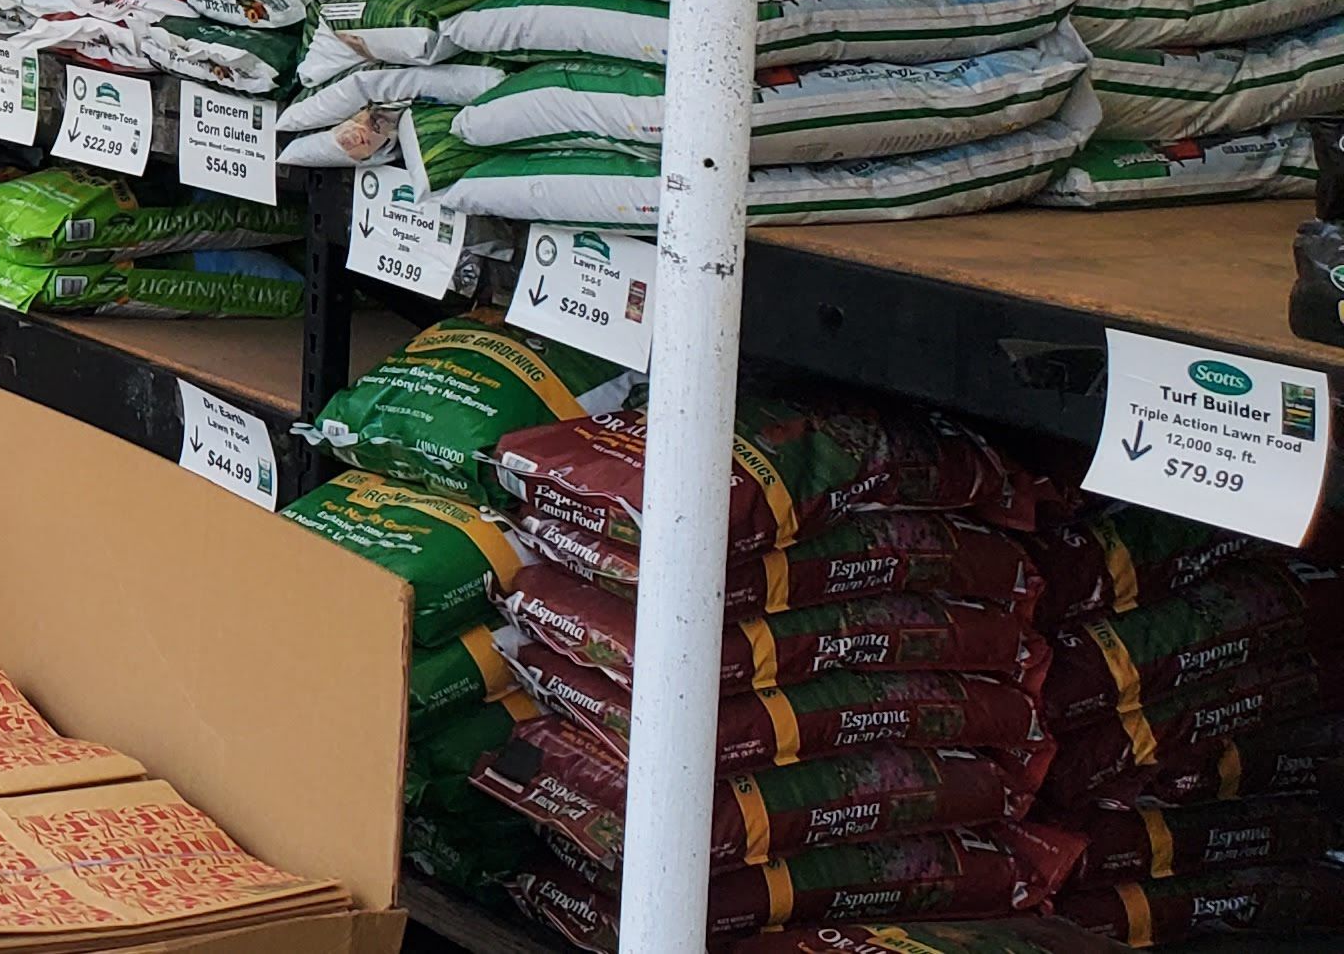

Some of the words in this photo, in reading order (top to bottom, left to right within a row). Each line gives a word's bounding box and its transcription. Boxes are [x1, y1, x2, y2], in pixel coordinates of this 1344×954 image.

[0, 64, 20, 79] Acting
[79, 104, 139, 127] Evergreen-Tone
[206, 99, 249, 120] Concern
[82, 135, 123, 156] $22.99
[196, 121, 221, 137] Corn
[223, 125, 258, 145] Gluten
[205, 155, 247, 179] $54.99
[382, 206, 408, 223] Lawn
[411, 214, 435, 231] Food
[392, 227, 421, 244] Organic
[376, 254, 422, 283] $39.99
[573, 255, 597, 272] Lawn
[598, 264, 620, 280] Food
[248, 284, 291, 307] LIME
[559, 297, 610, 327] $29.99
[474, 336, 547, 384] GARDENING
[1195, 364, 1245, 390] Scotts
[203, 397, 218, 413] Dr.
[218, 405, 246, 428] Earth
[1160, 385, 1197, 407] Turf
[1203, 395, 1272, 424] Builder
[207, 416, 228, 434] Lawn
[230, 428, 250, 445] Food
[1129, 402, 1169, 423] Triple
[1172, 413, 1218, 435] Action
[1222, 423, 1262, 445] Lawn
[1266, 434, 1302, 454] Food
[439, 443, 464, 464] FOOD
[1165, 433, 1212, 453] 12,000
[1216, 447, 1238, 461] sq.
[1241, 450, 1257, 465] ft.
[207, 449, 252, 484] $44.99
[1163, 458, 1244, 493] $79.99
[534, 485, 606, 517] Espoma
[534, 498, 571, 522] Lawn
[572, 513, 605, 534] Food
[543, 525, 601, 565] Espoma
[527, 598, 586, 641] Espoma
[817, 631, 890, 659] Espoma
[1177, 637, 1250, 670] Espoma
[547, 675, 603, 714] Espoma
[840, 709, 911, 731] Espoma
[1194, 695, 1263, 728] Espoma
[810, 799, 881, 827] Espoma
[539, 880, 598, 923] Espoma
[831, 887, 902, 908] Espoma
